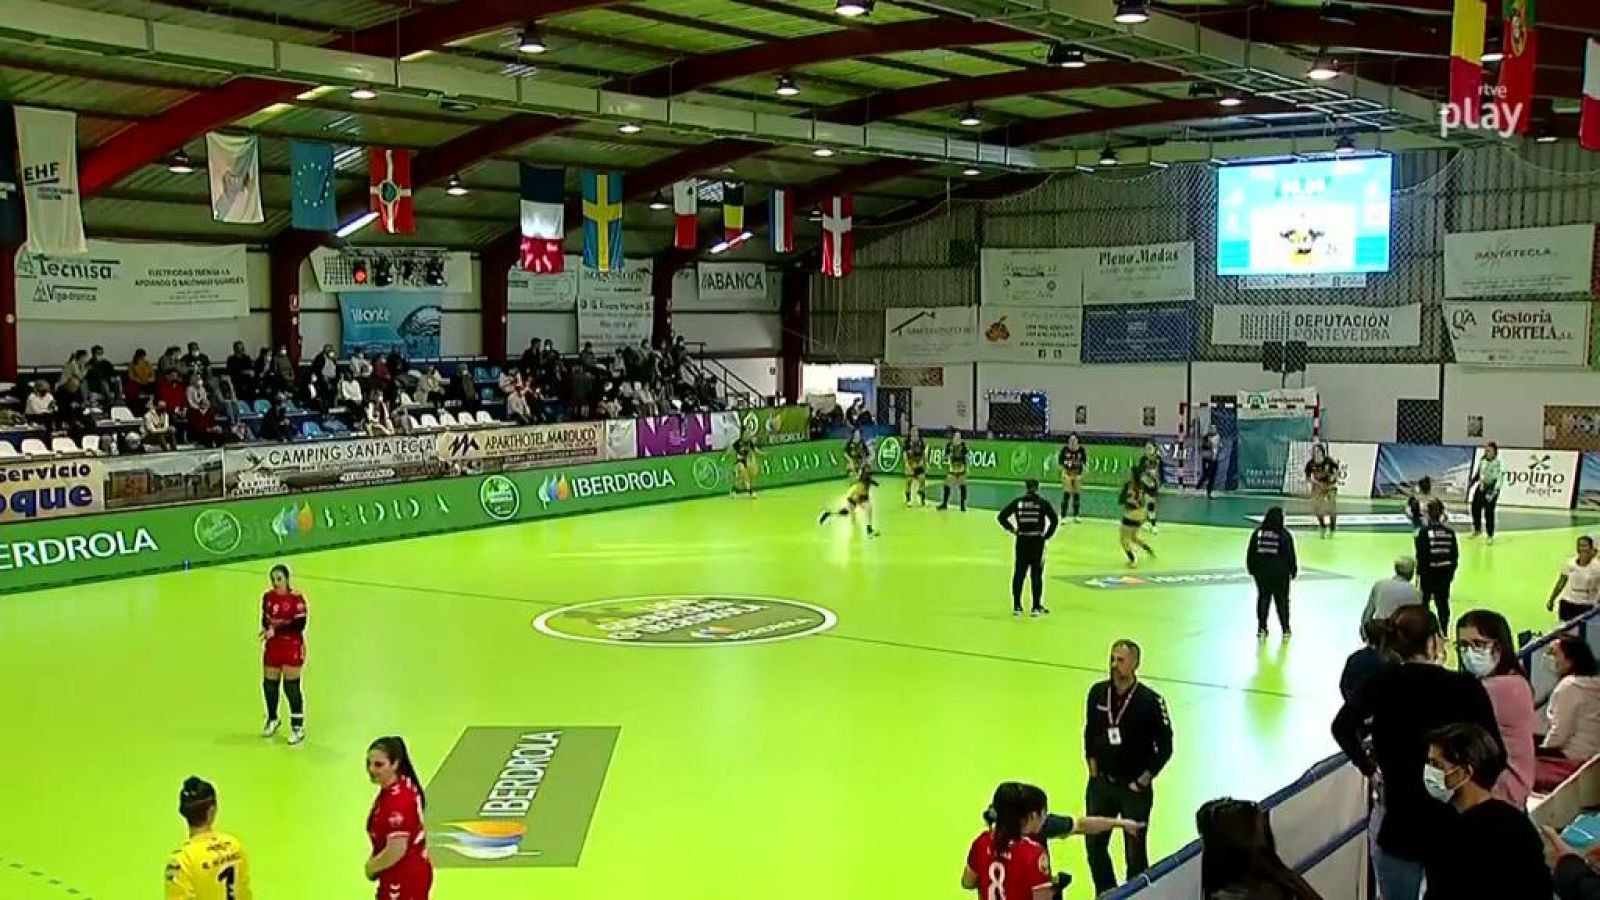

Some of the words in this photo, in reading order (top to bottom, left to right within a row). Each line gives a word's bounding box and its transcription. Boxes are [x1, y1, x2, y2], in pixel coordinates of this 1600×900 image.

[24, 161, 60, 181] EHF
[707, 271, 764, 291] ABANCA
[268, 446, 342, 466] CAMPING
[346, 442, 392, 459] SANTA
[394, 438, 434, 454] TECLA
[571, 468, 676, 498] IBERDROLA
[0, 485, 93, 518] que
[480, 730, 563, 817] IBERDROLA
[217, 866, 236, 900] 1
[988, 861, 1006, 900] 8
